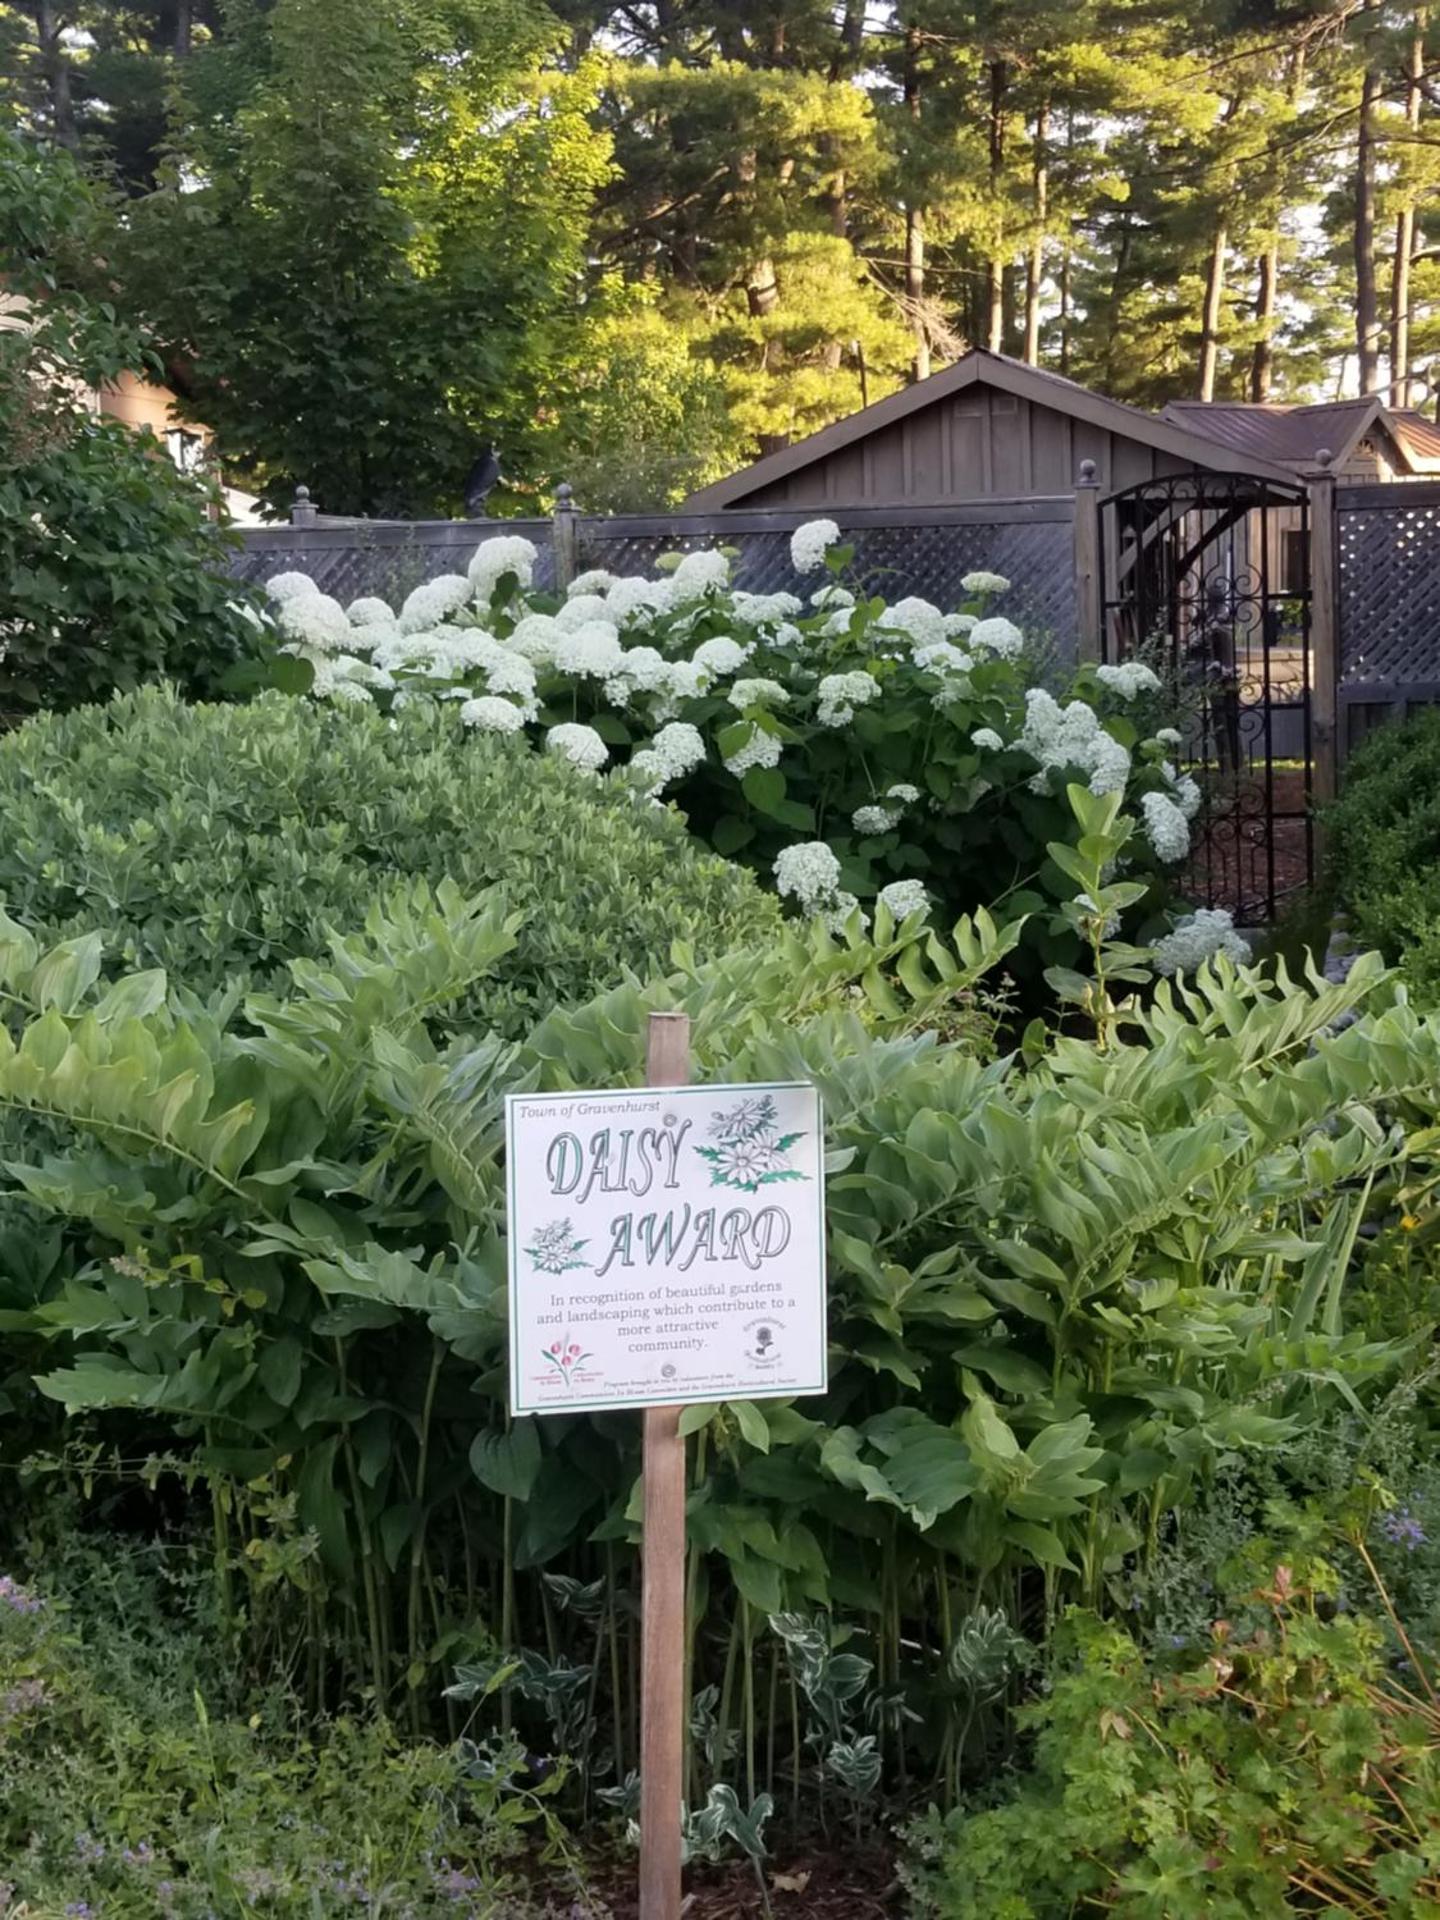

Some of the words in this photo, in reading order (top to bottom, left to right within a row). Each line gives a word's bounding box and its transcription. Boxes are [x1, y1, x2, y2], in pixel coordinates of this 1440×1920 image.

[520, 1105, 556, 1118] Town
[561, 1103, 575, 1118] of
[577, 1101, 660, 1116] Gravenhurst
[546, 1118, 692, 1204] DAISY
[594, 1202, 791, 1277] AWARD
[551, 1294, 564, 1306] In
[569, 1290, 645, 1305] recognition
[649, 1286, 662, 1300] of
[666, 1283, 725, 1299] beautiful
[730, 1281, 782, 1297] gardens
[537, 1311, 563, 1324] and
[567, 1306, 650, 1322] landscaping
[653, 1303, 693, 1317] which
[698, 1299, 767, 1314] contribute
[771, 1298, 784, 1309] to
[788, 1299, 796, 1308] a
[617, 1325, 651, 1336] more
[656, 1320, 719, 1334] attractive
[628, 1337, 708, 1353] community.
